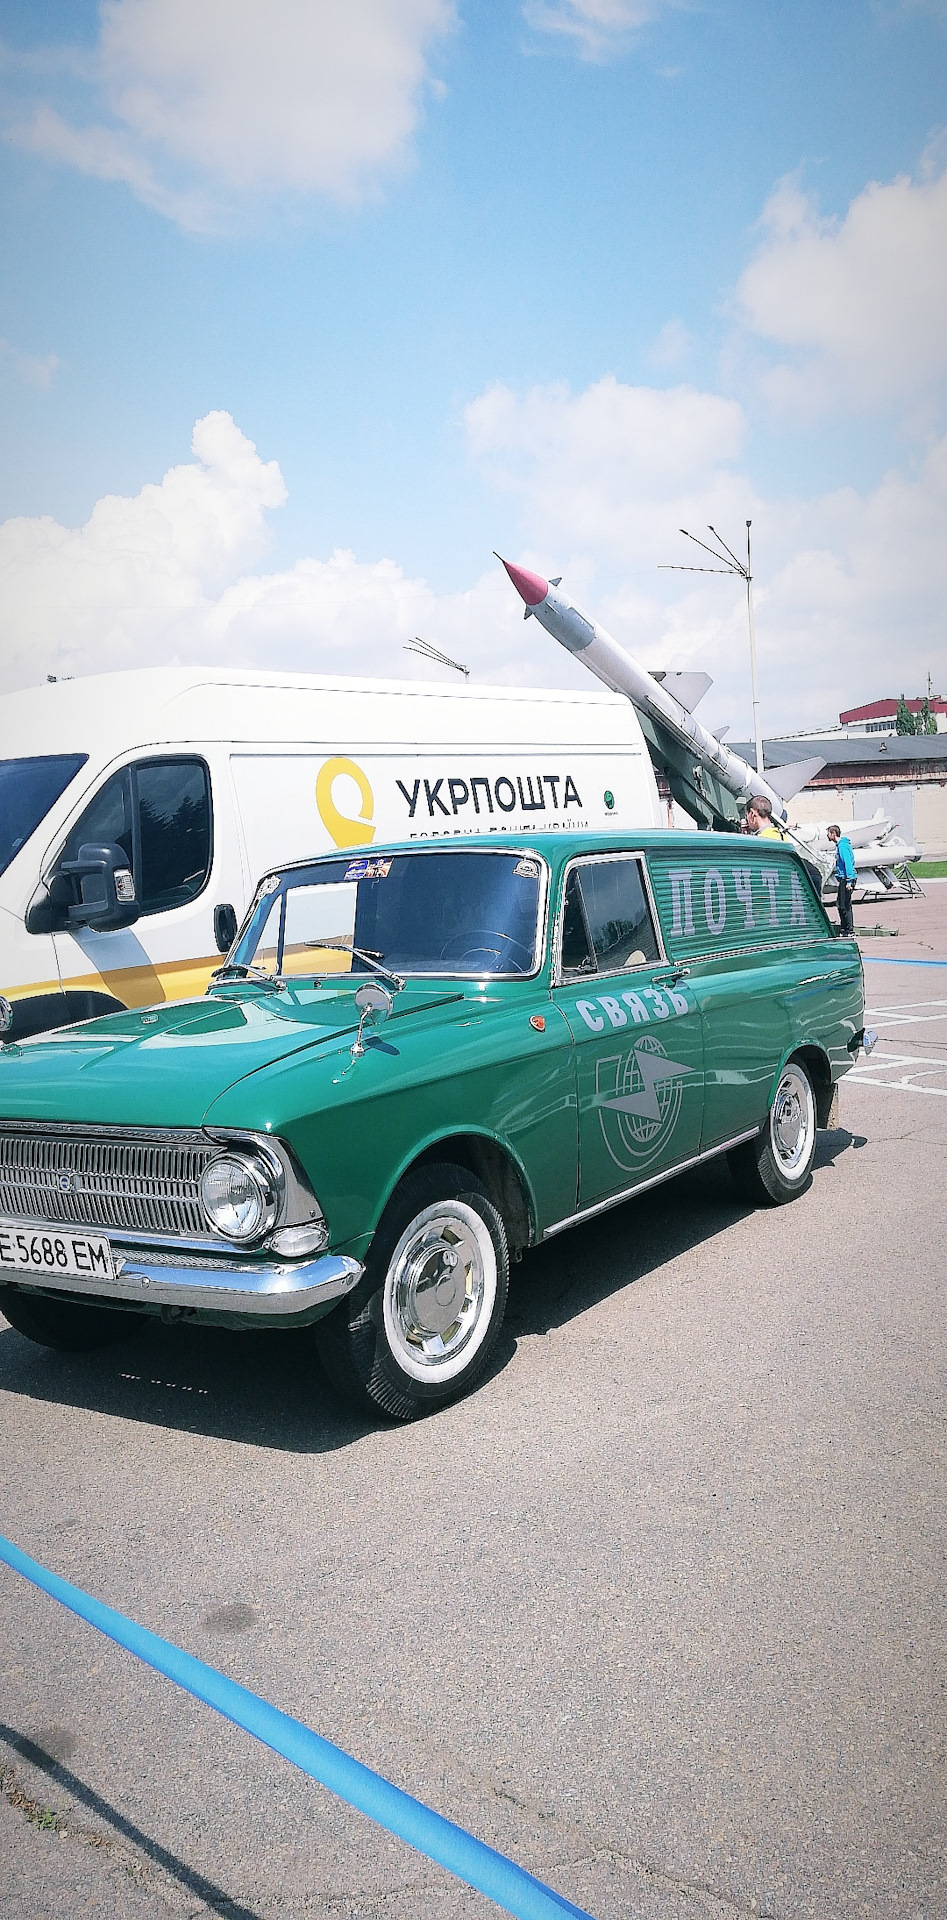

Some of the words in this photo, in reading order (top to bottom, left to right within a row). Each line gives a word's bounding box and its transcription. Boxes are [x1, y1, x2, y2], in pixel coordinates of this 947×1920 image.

[395, 775, 582, 817] УКРПОШТА
[669, 868, 807, 937] ПОЧТА
[575, 987, 689, 1032] СВЯЗЬ
[16, 1235, 68, 1268] 5688
[71, 1240, 108, 1274] EM
